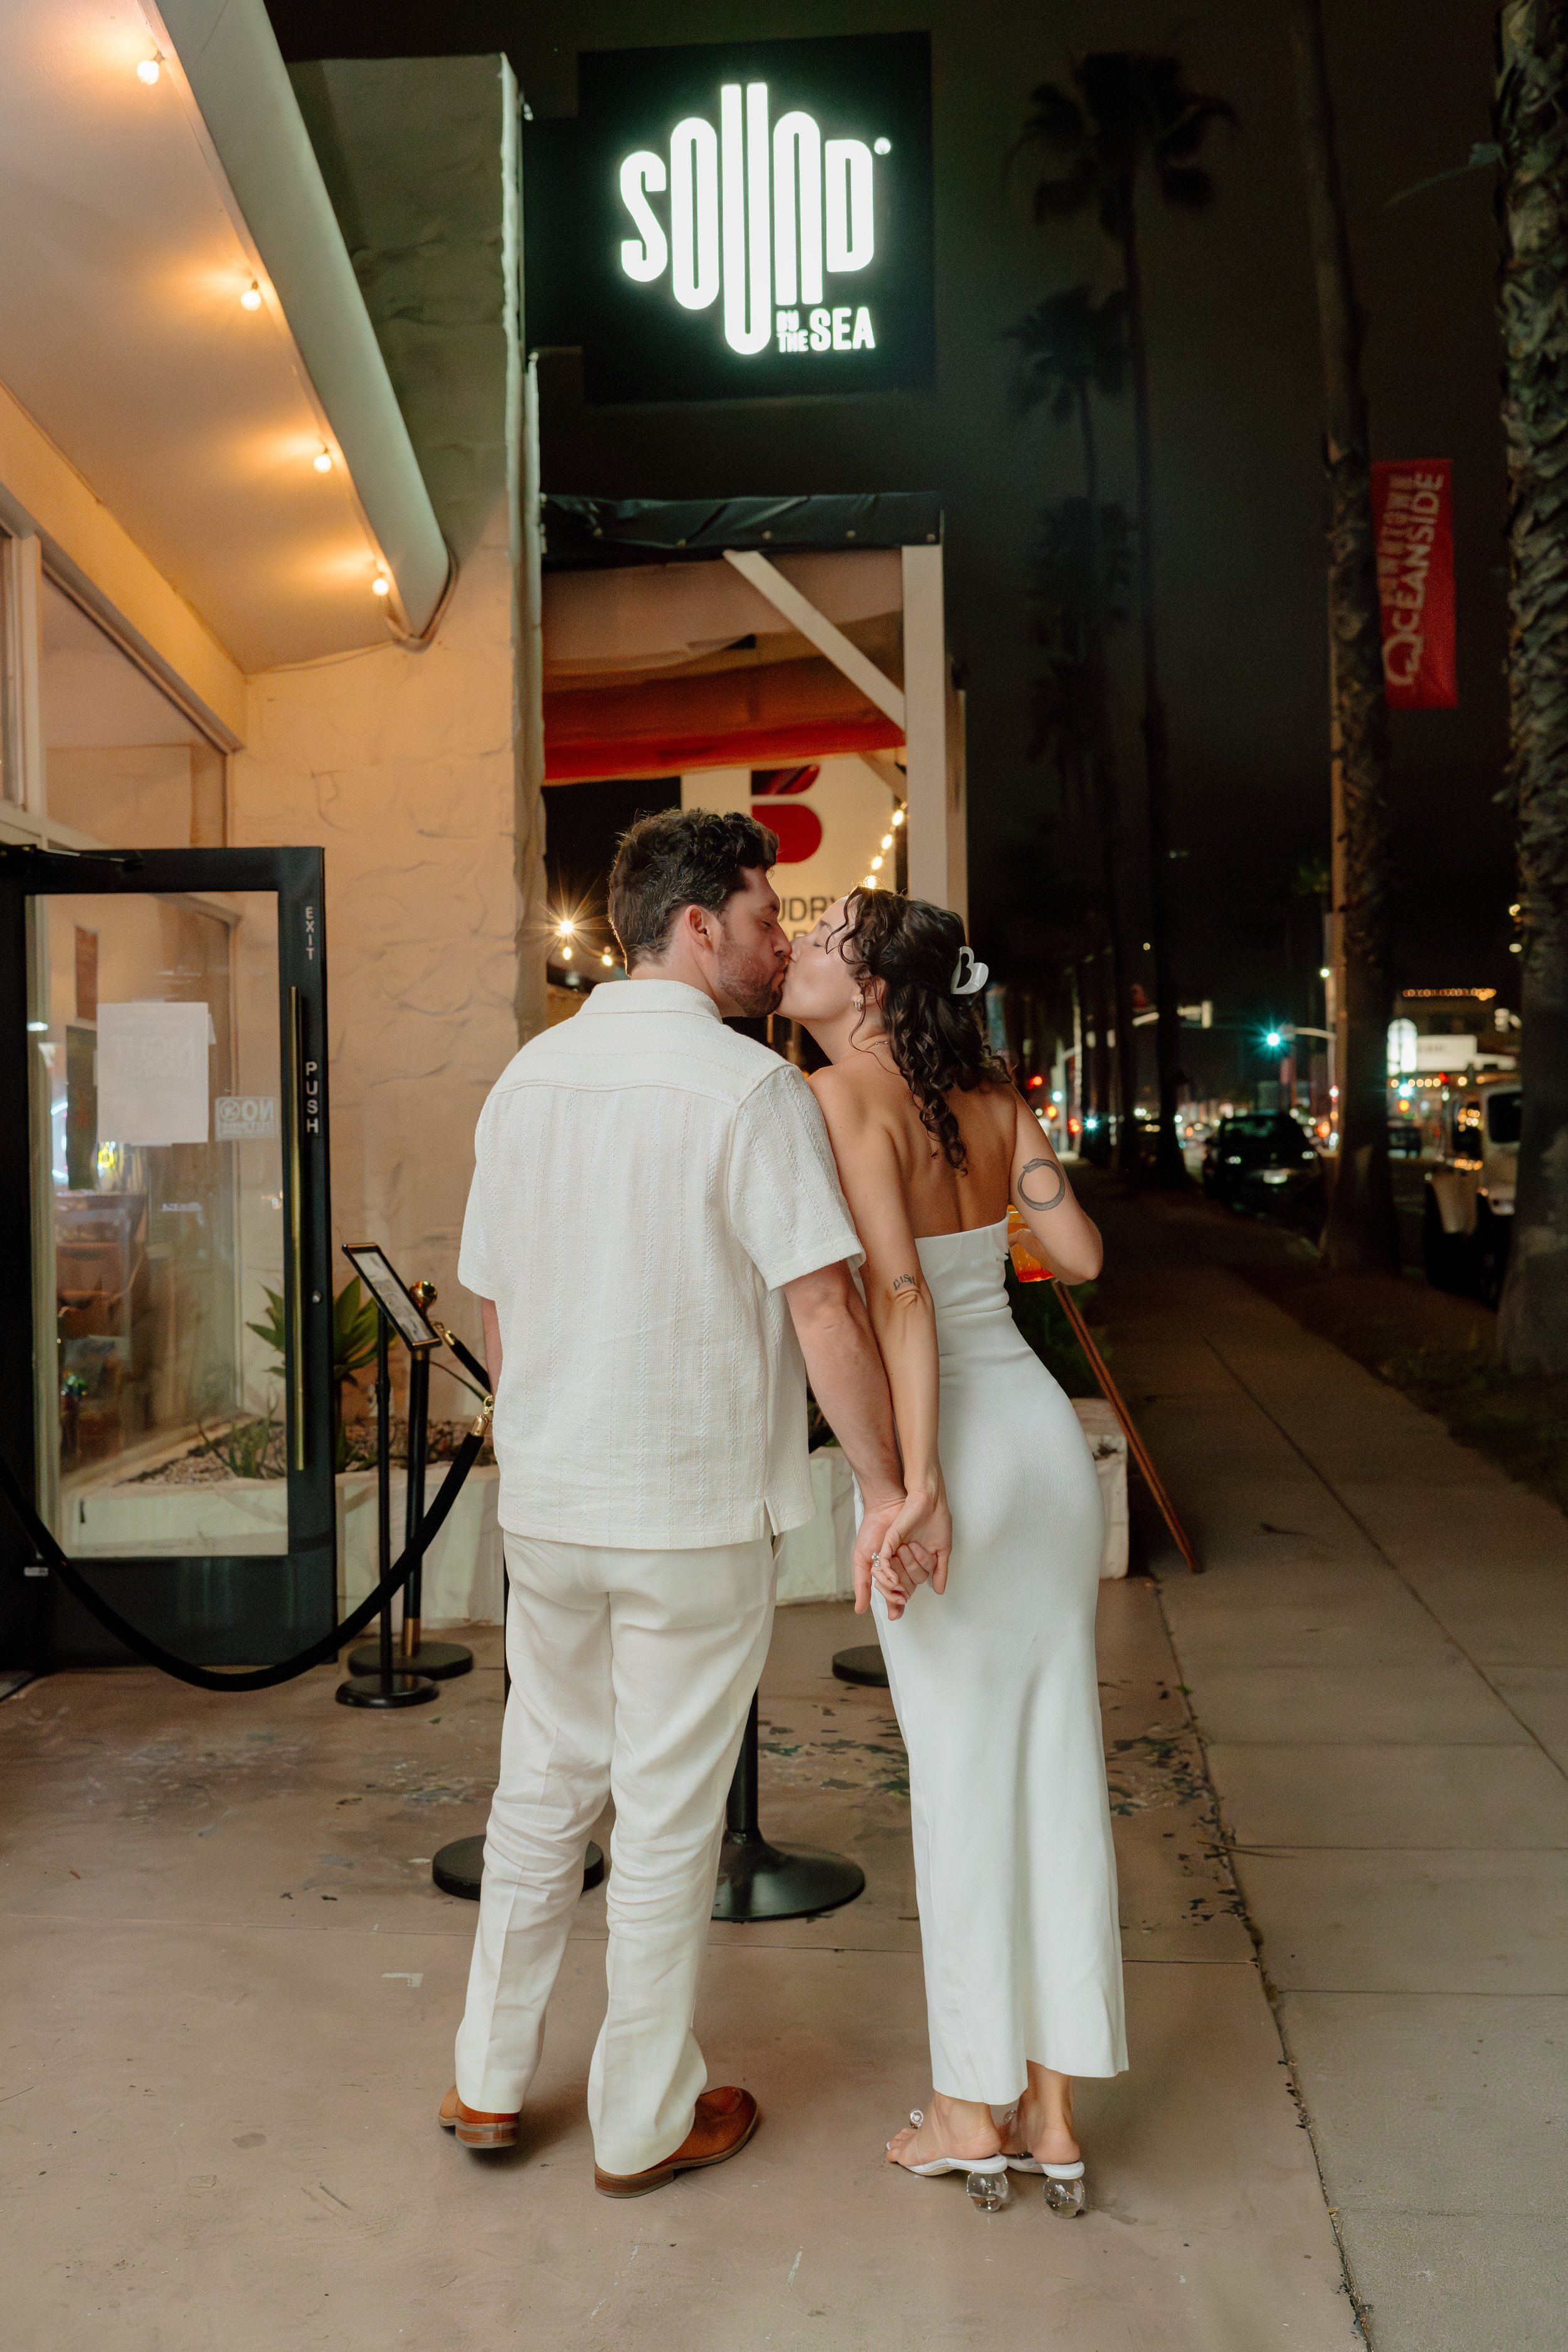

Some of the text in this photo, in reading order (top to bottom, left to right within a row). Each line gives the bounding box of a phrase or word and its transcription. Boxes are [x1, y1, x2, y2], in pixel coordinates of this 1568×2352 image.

[620, 82, 874, 355] SOUND
[776, 307, 876, 353] THE SEA
[1382, 472, 1443, 686] OCEANSIDE
[305, 906, 315, 960] EXIT
[305, 1061, 319, 1133] PUSH
